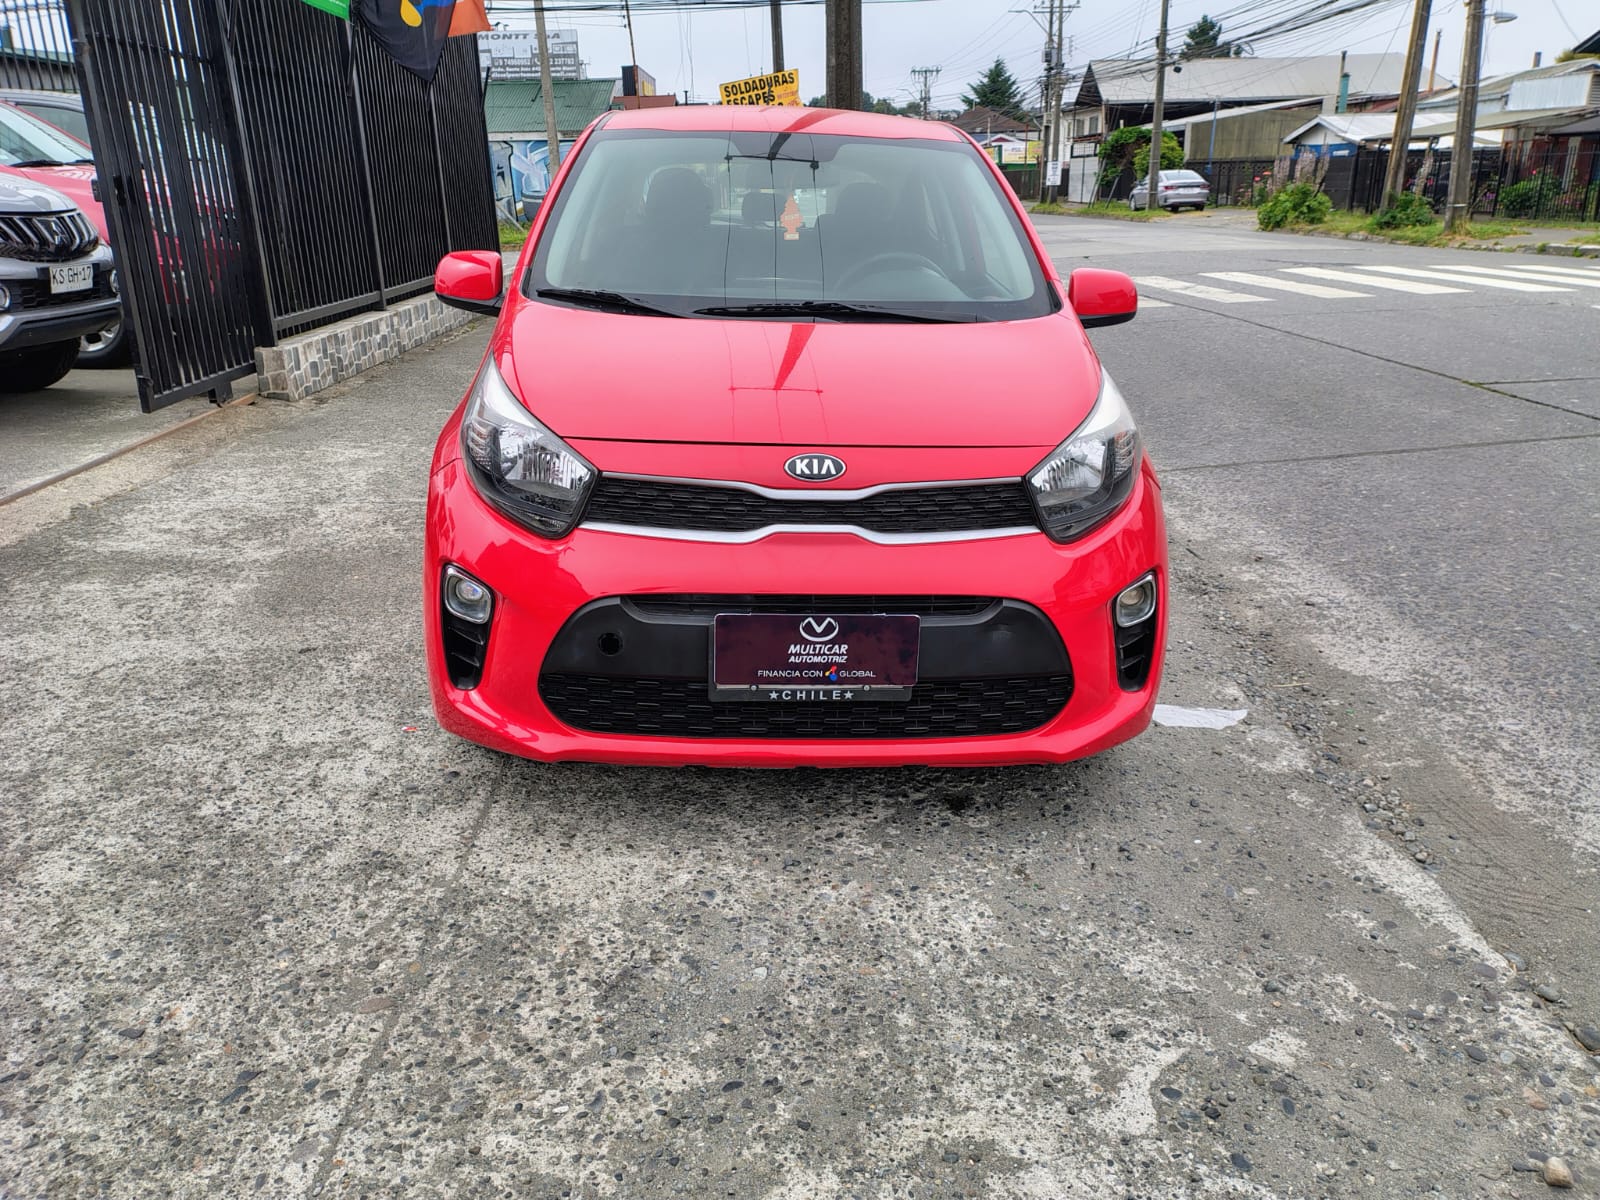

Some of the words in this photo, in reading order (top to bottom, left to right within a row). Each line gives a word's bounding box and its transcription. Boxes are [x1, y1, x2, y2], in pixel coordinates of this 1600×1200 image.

[724, 72, 795, 98] SOLDADURAS
[795, 458, 837, 475] KIA
[788, 644, 848, 655] MULTICAR
[788, 655, 848, 663] AUTOMOTRIZ
[757, 670, 801, 678] FINANCIA
[802, 670, 823, 678] CON
[839, 670, 876, 678] GLOBAL
[782, 690, 842, 700] CHILE
